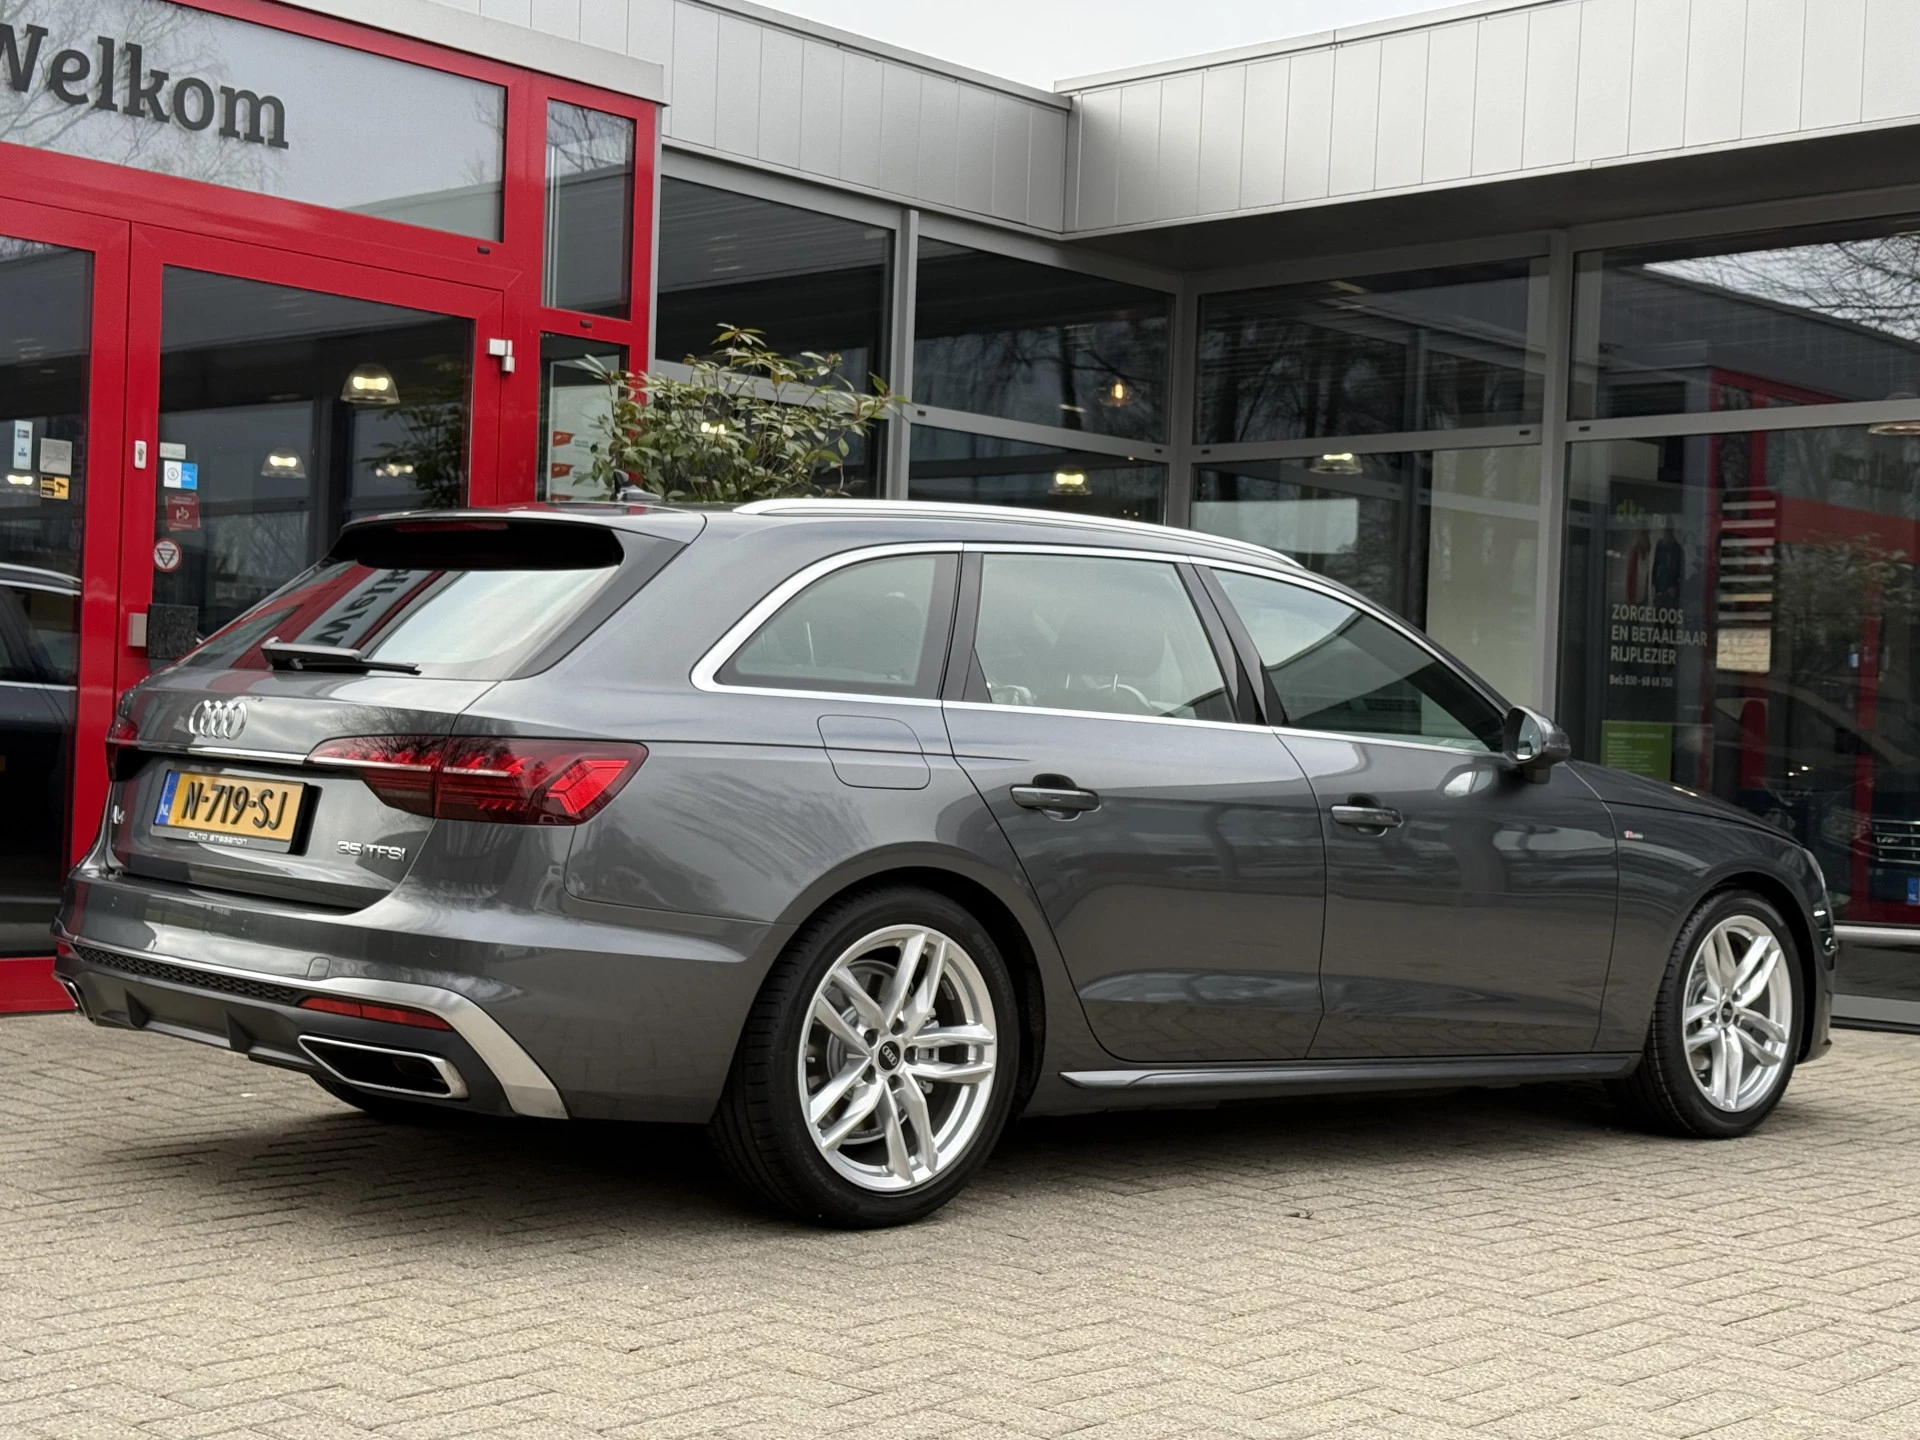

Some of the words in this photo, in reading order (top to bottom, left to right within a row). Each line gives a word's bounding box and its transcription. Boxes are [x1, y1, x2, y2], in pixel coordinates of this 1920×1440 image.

[1612, 604, 1684, 625] ZORGELOOS
[1612, 625, 1629, 641] EN
[1632, 627, 1708, 647] BETAALBAAR
[1611, 646, 1676, 665] RIJPLEZIER
[181, 781, 288, 831] N-719-SJ
[336, 840, 363, 856] 35
[366, 844, 407, 862] TFSI
